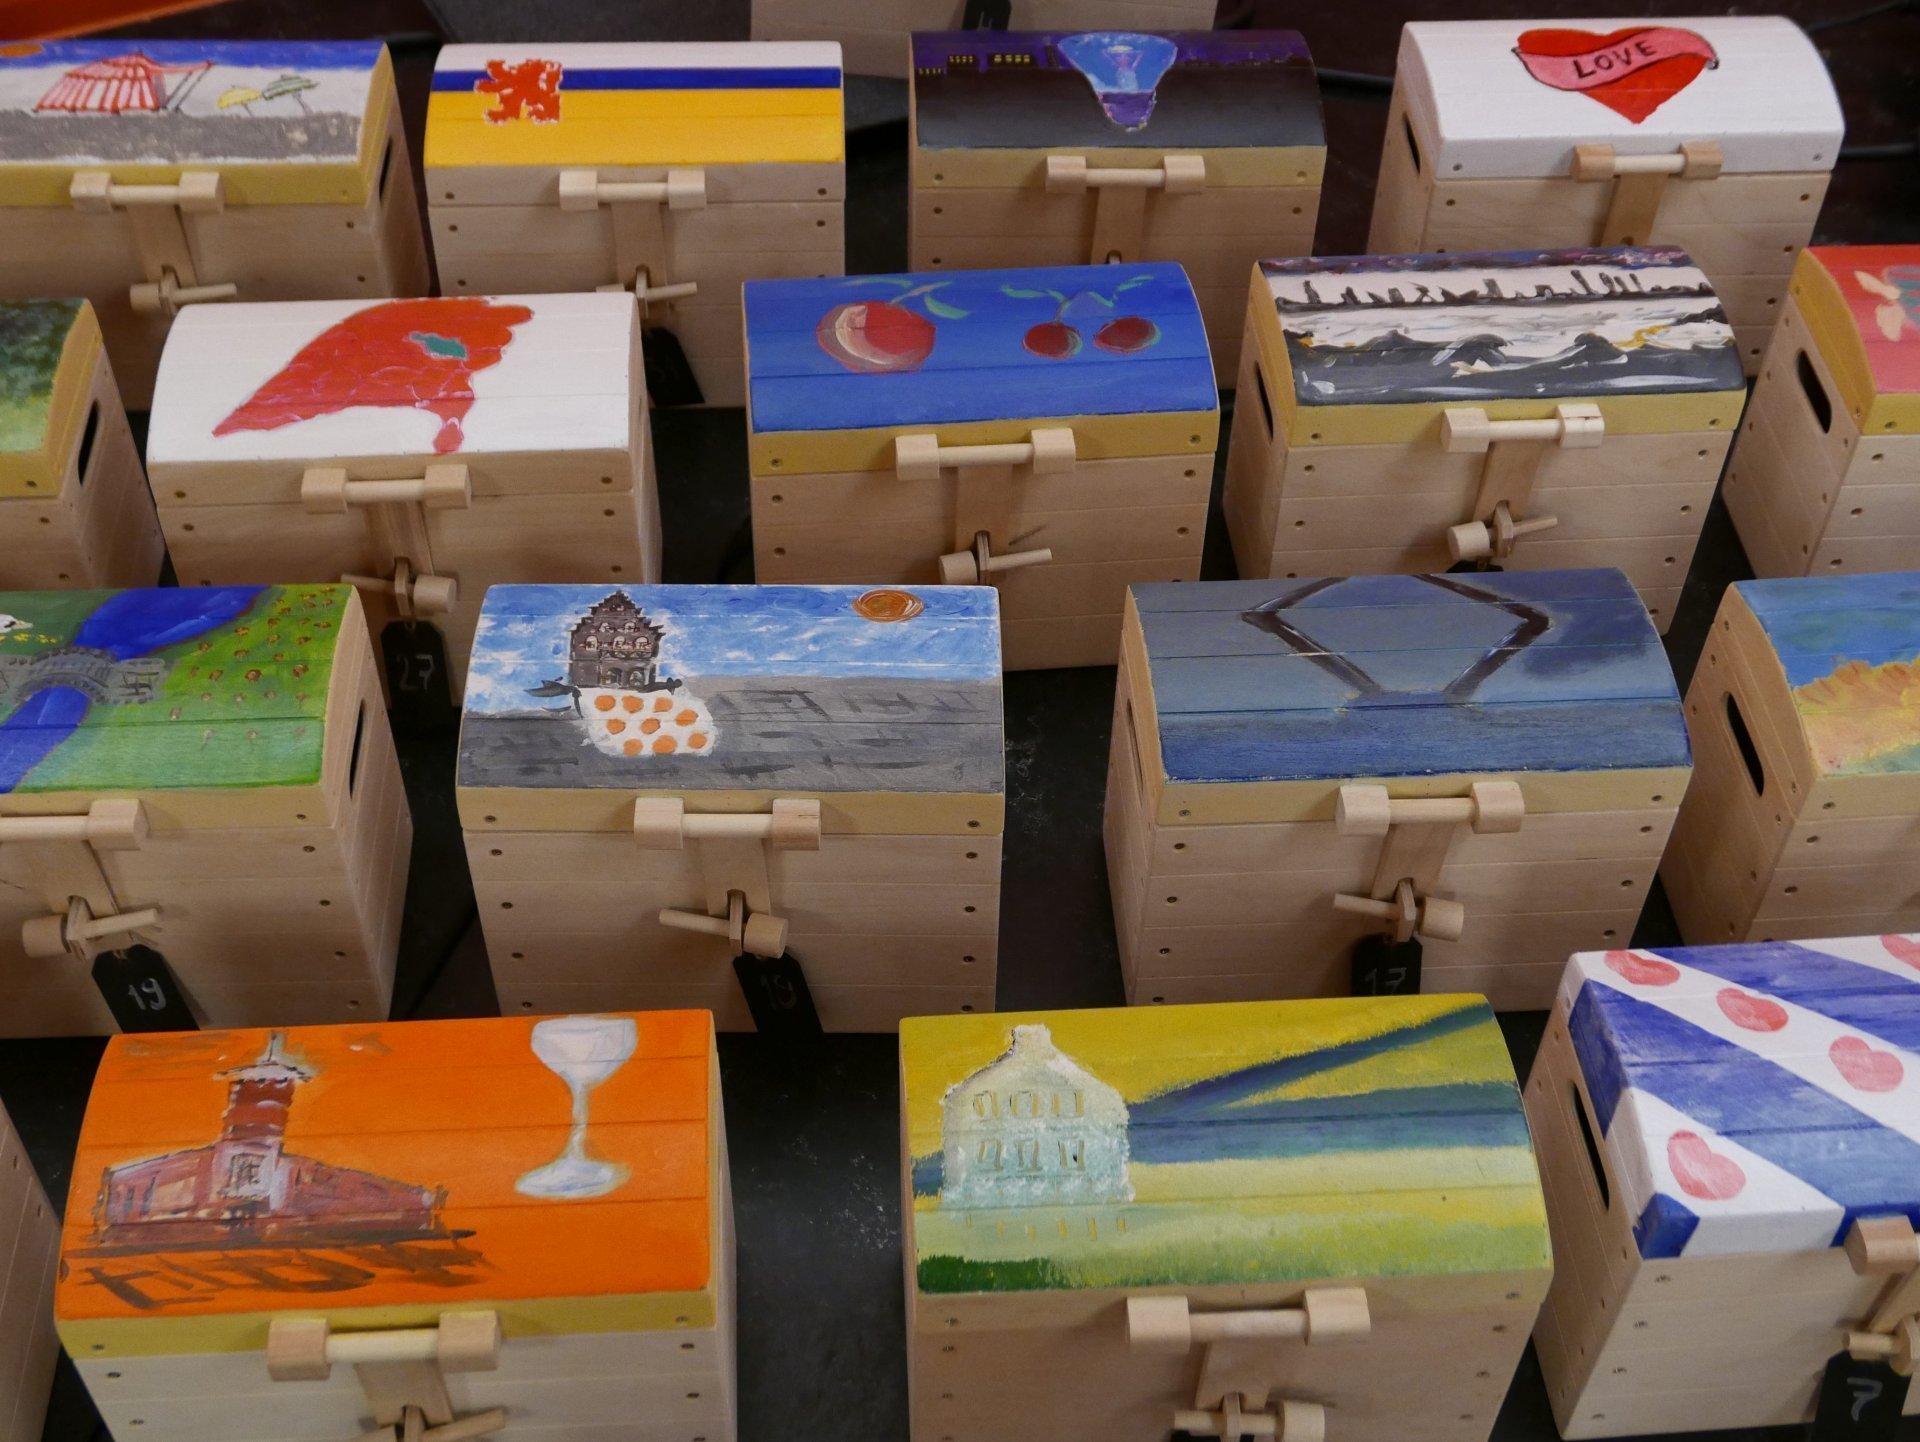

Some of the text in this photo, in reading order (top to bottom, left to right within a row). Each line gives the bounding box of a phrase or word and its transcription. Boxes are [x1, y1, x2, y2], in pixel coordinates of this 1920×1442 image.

[1572, 39, 1657, 79] LOVE
[395, 653, 435, 693] 27
[127, 977, 167, 1011] 19
[1364, 963, 1408, 995] 17
[1846, 1376, 1884, 1422] 7
